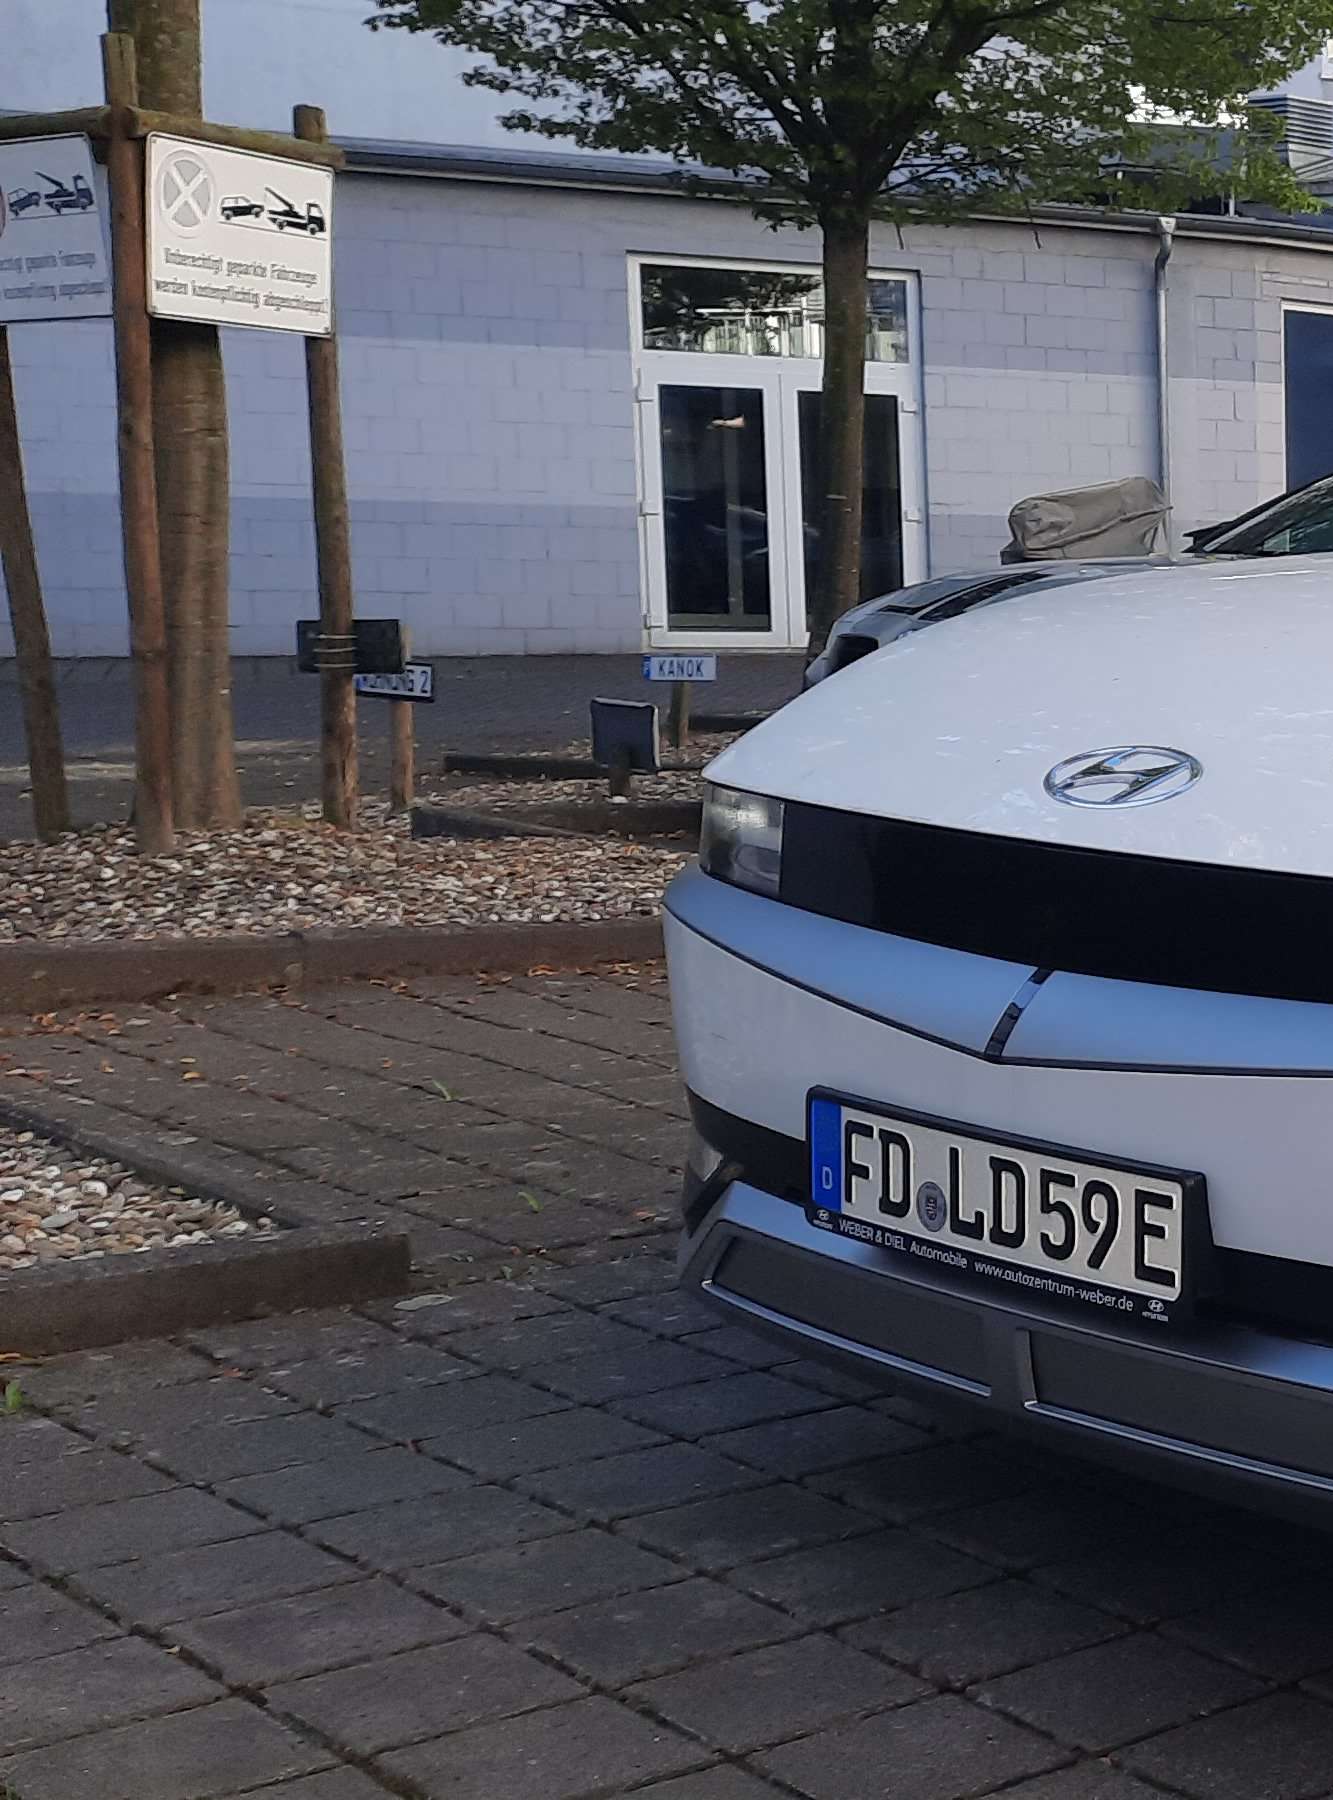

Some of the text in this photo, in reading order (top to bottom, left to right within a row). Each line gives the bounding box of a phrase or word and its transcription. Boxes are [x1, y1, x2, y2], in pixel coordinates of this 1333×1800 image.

[658, 659, 704, 678] KANOK
[420, 670, 429, 693] 2
[822, 1165, 833, 1190] D
[844, 1119, 912, 1219] FD
[839, 1219, 874, 1241] WEBER
[875, 1230, 883, 1244] &
[884, 1233, 907, 1251] DIEL
[910, 1240, 968, 1269] Automobile
[974, 1260, 1134, 1312] www.autozentrum-weber.de
